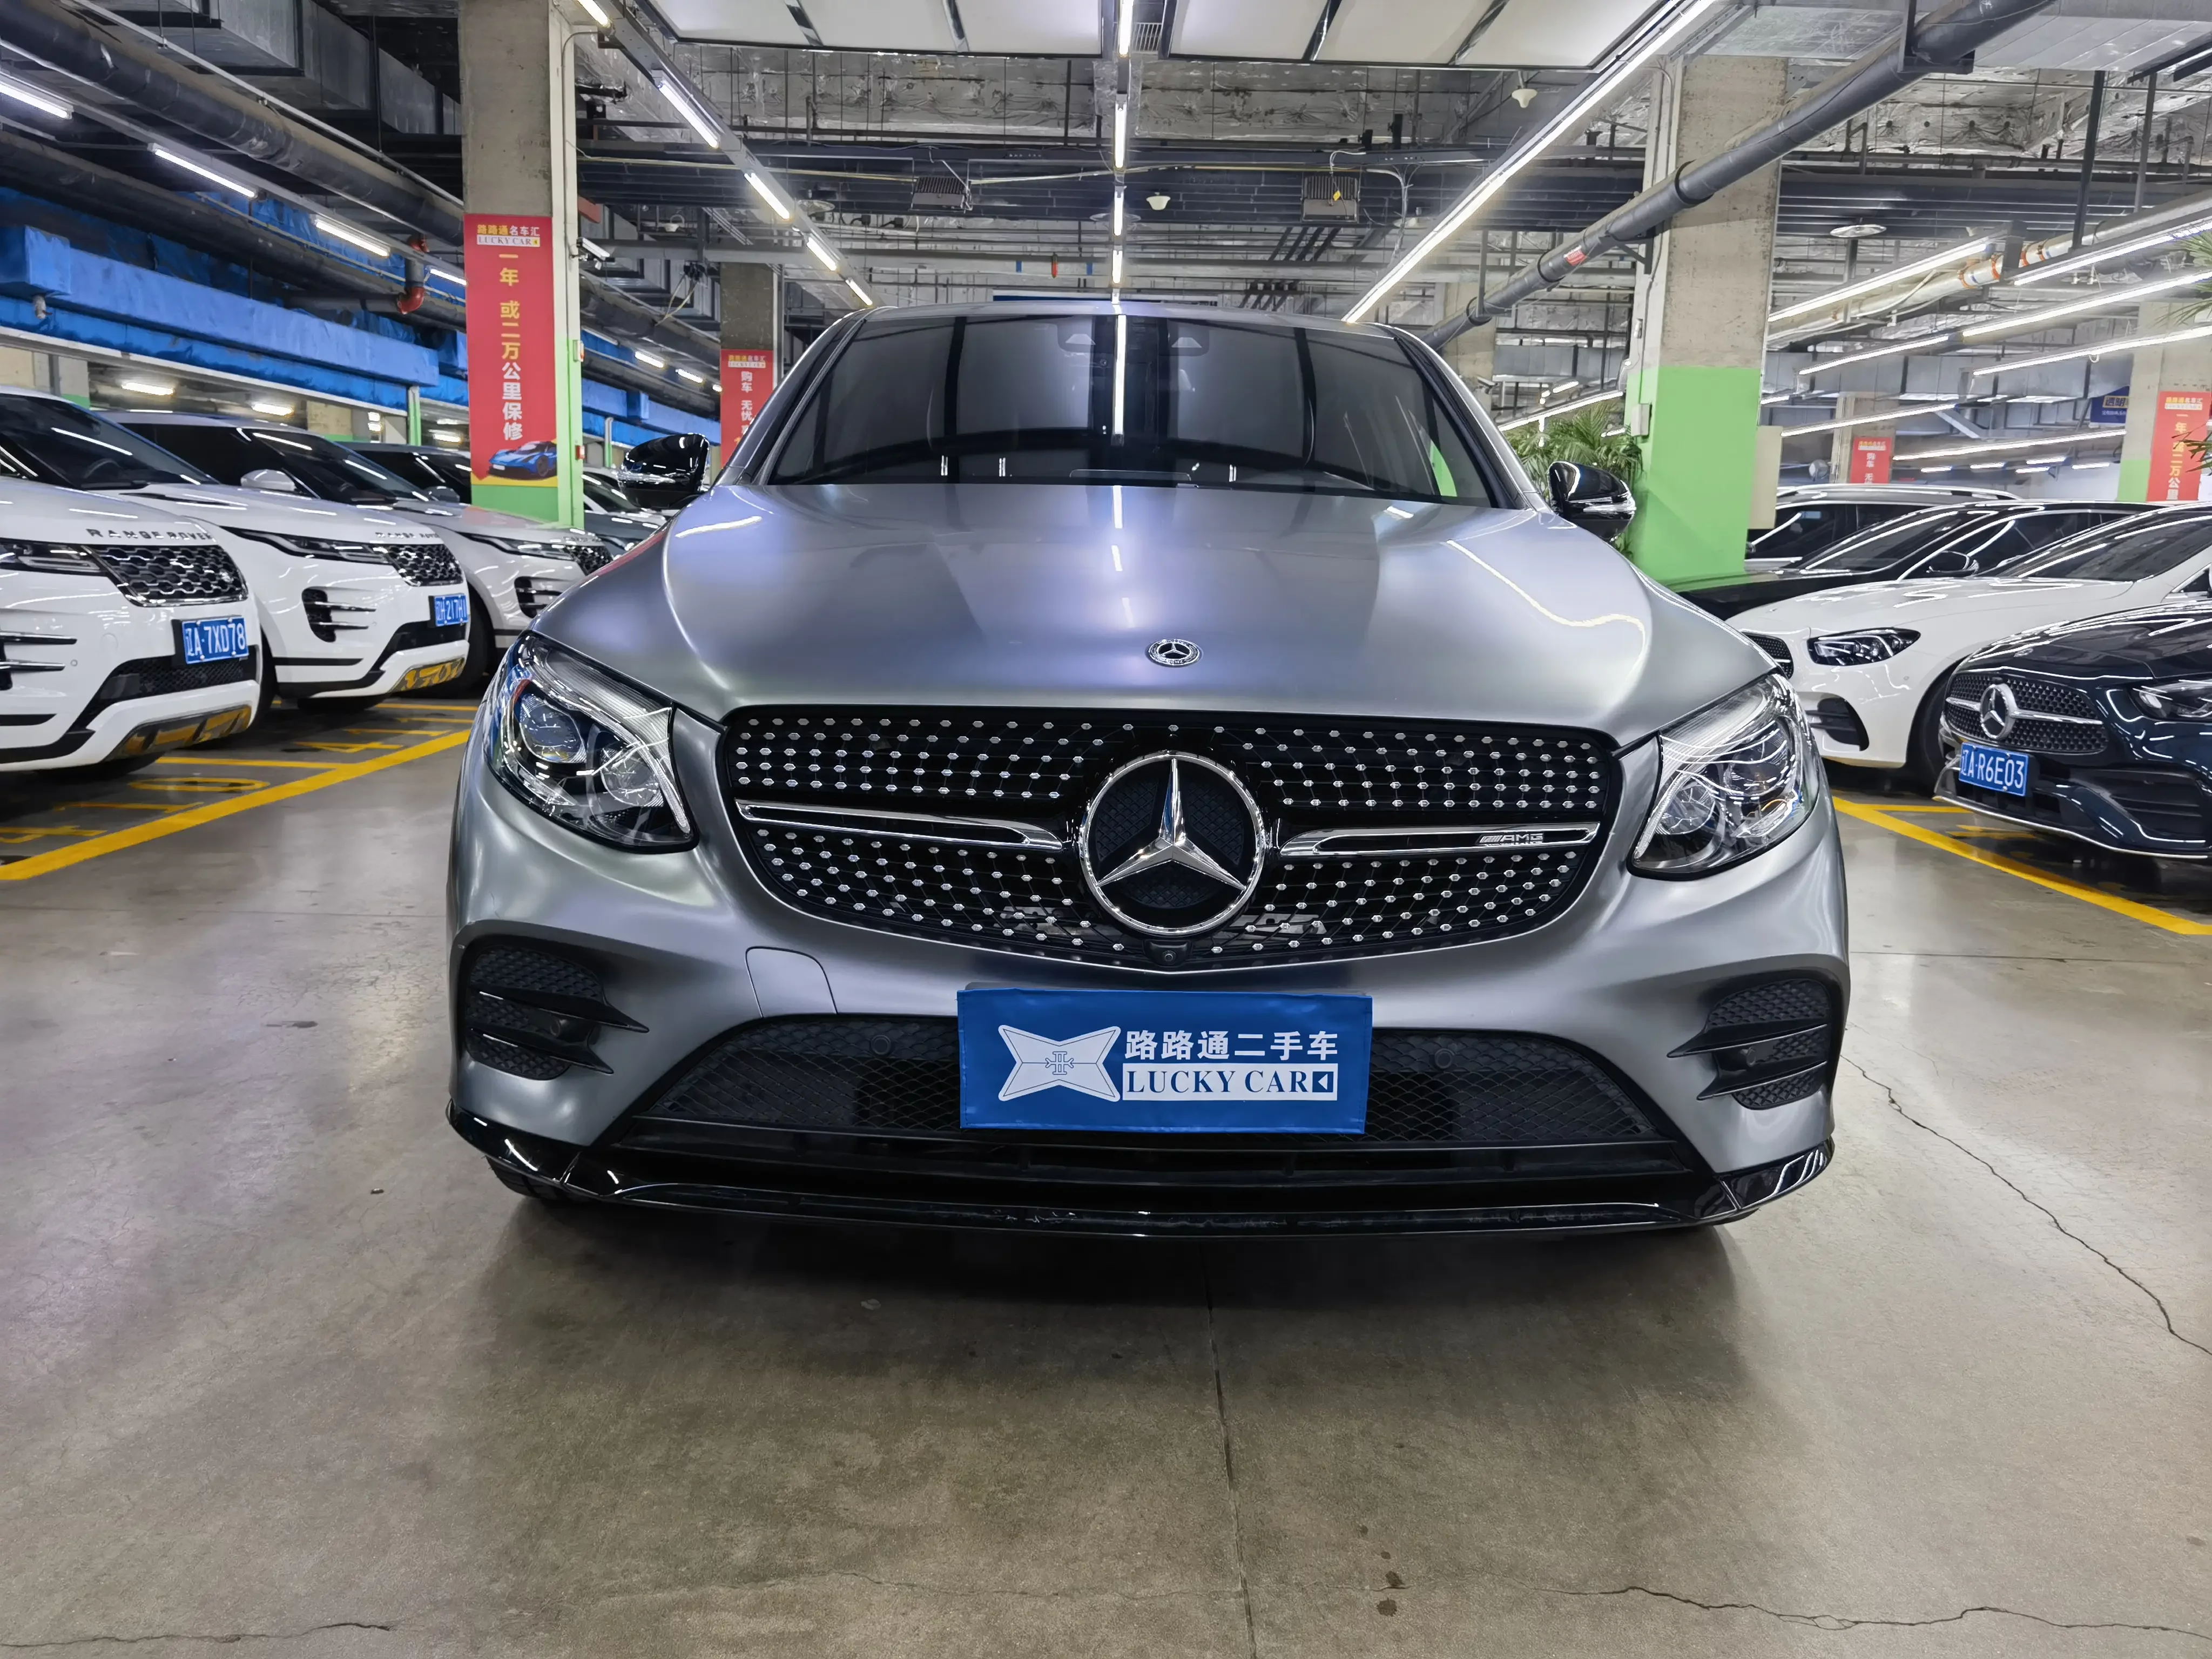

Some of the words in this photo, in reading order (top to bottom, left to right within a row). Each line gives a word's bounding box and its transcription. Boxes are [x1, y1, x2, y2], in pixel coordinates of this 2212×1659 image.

[478, 235, 510, 245] LUCKY
[512, 237, 532, 245] CAR
[500, 300, 523, 440] 或二万公里保修
[86, 528, 164, 538] RANGE
[1500, 833, 1543, 842] AMG
[1125, 1030, 1338, 1061] 路路通二手车
[1127, 1070, 1236, 1094] LUCKY
[1245, 1070, 1309, 1094] CAR
